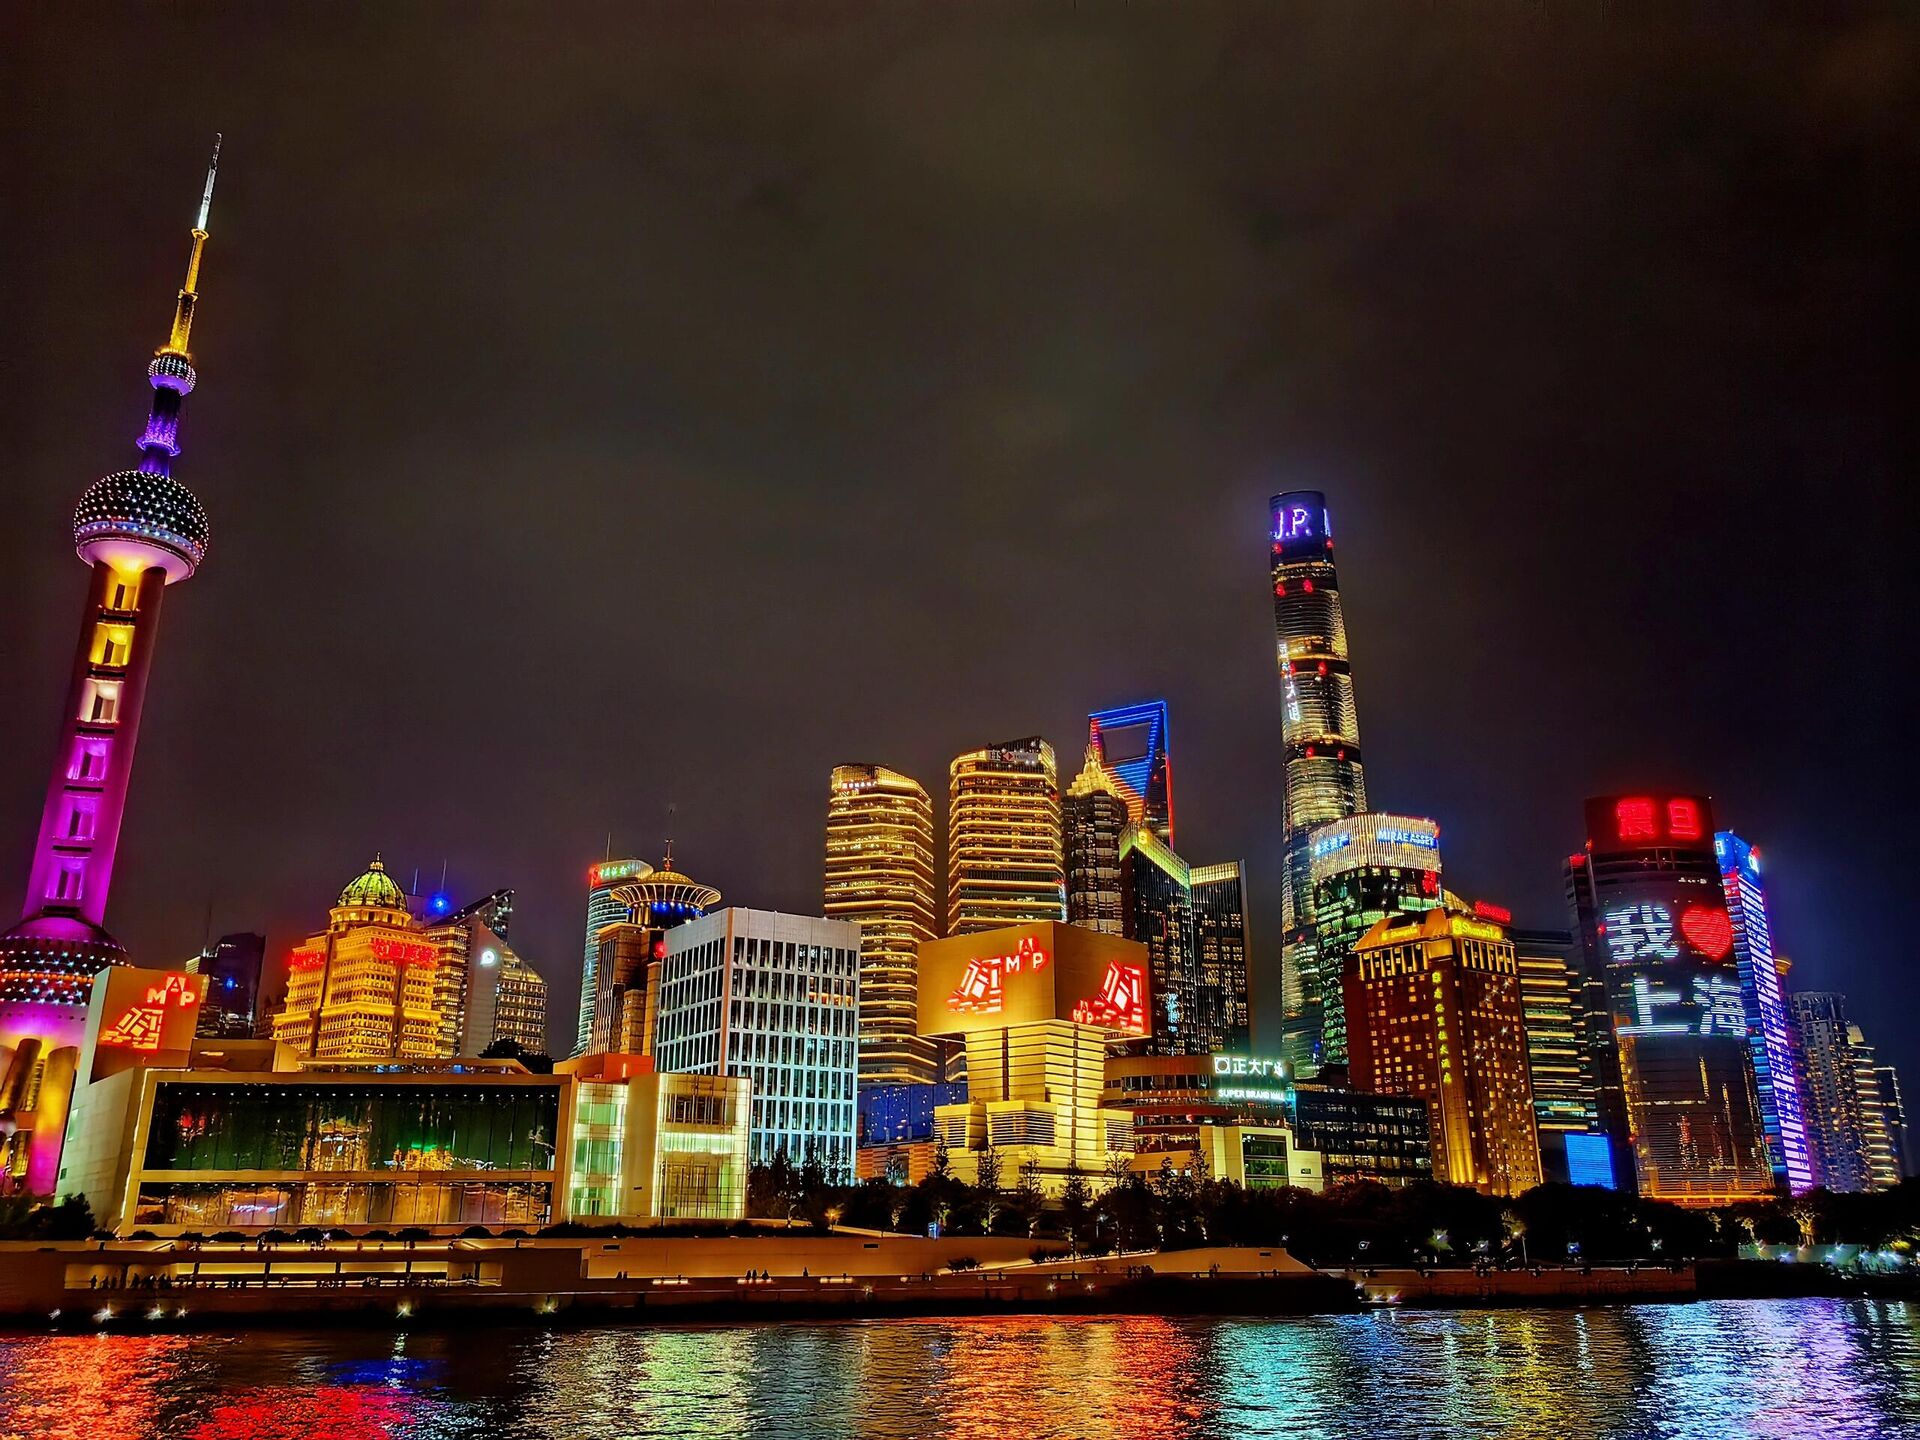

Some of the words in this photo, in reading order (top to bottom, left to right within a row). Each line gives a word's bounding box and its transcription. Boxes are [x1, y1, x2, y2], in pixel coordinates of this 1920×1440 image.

[1616, 800, 1700, 837] 震旦
[1378, 830, 1409, 842] MIRAE
[1409, 832, 1435, 846] ASSET
[1605, 904, 1680, 961] 我
[1005, 937, 1044, 973] MAP
[146, 975, 196, 1007] MAP
[1615, 975, 1747, 1037] 上海
[1231, 1057, 1284, 1078] 正大广场
[1218, 1089, 1245, 1100] SUPER
[1245, 1090, 1270, 1101] BRAND
